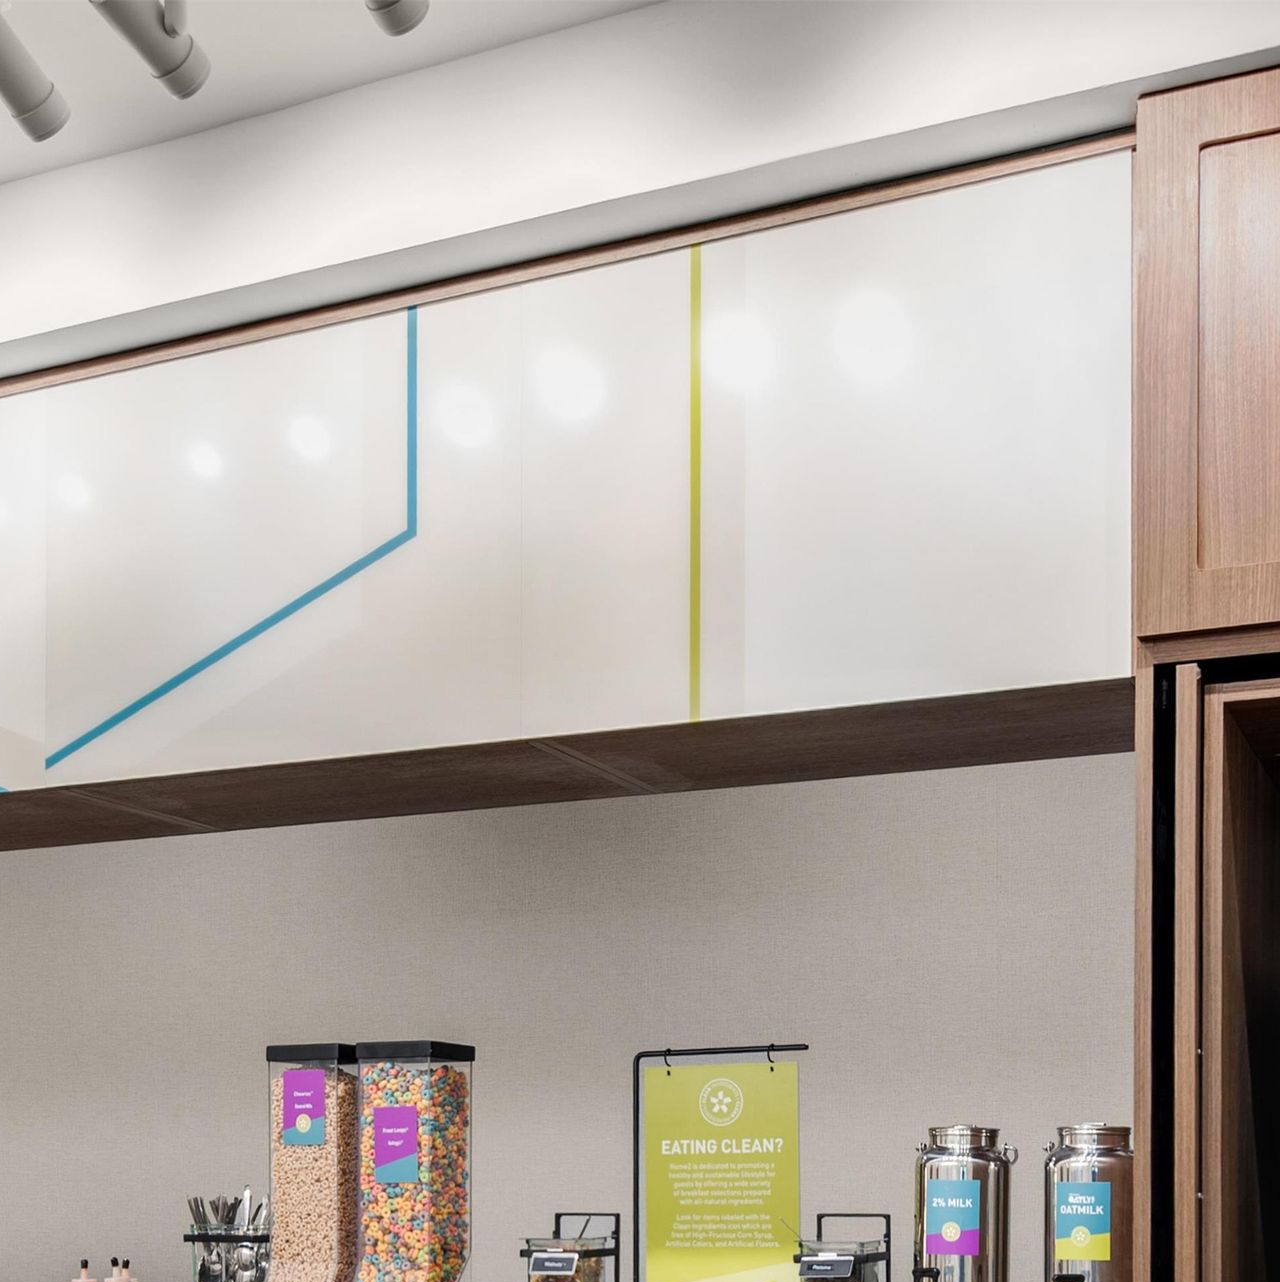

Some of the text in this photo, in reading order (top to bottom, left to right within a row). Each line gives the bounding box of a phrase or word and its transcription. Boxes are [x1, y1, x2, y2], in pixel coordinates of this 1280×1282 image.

[662, 1138, 783, 1155] EATING CLEAN?
[932, 1198, 973, 1208] 2% MILK
[1060, 1205, 1104, 1215] OATMILK
